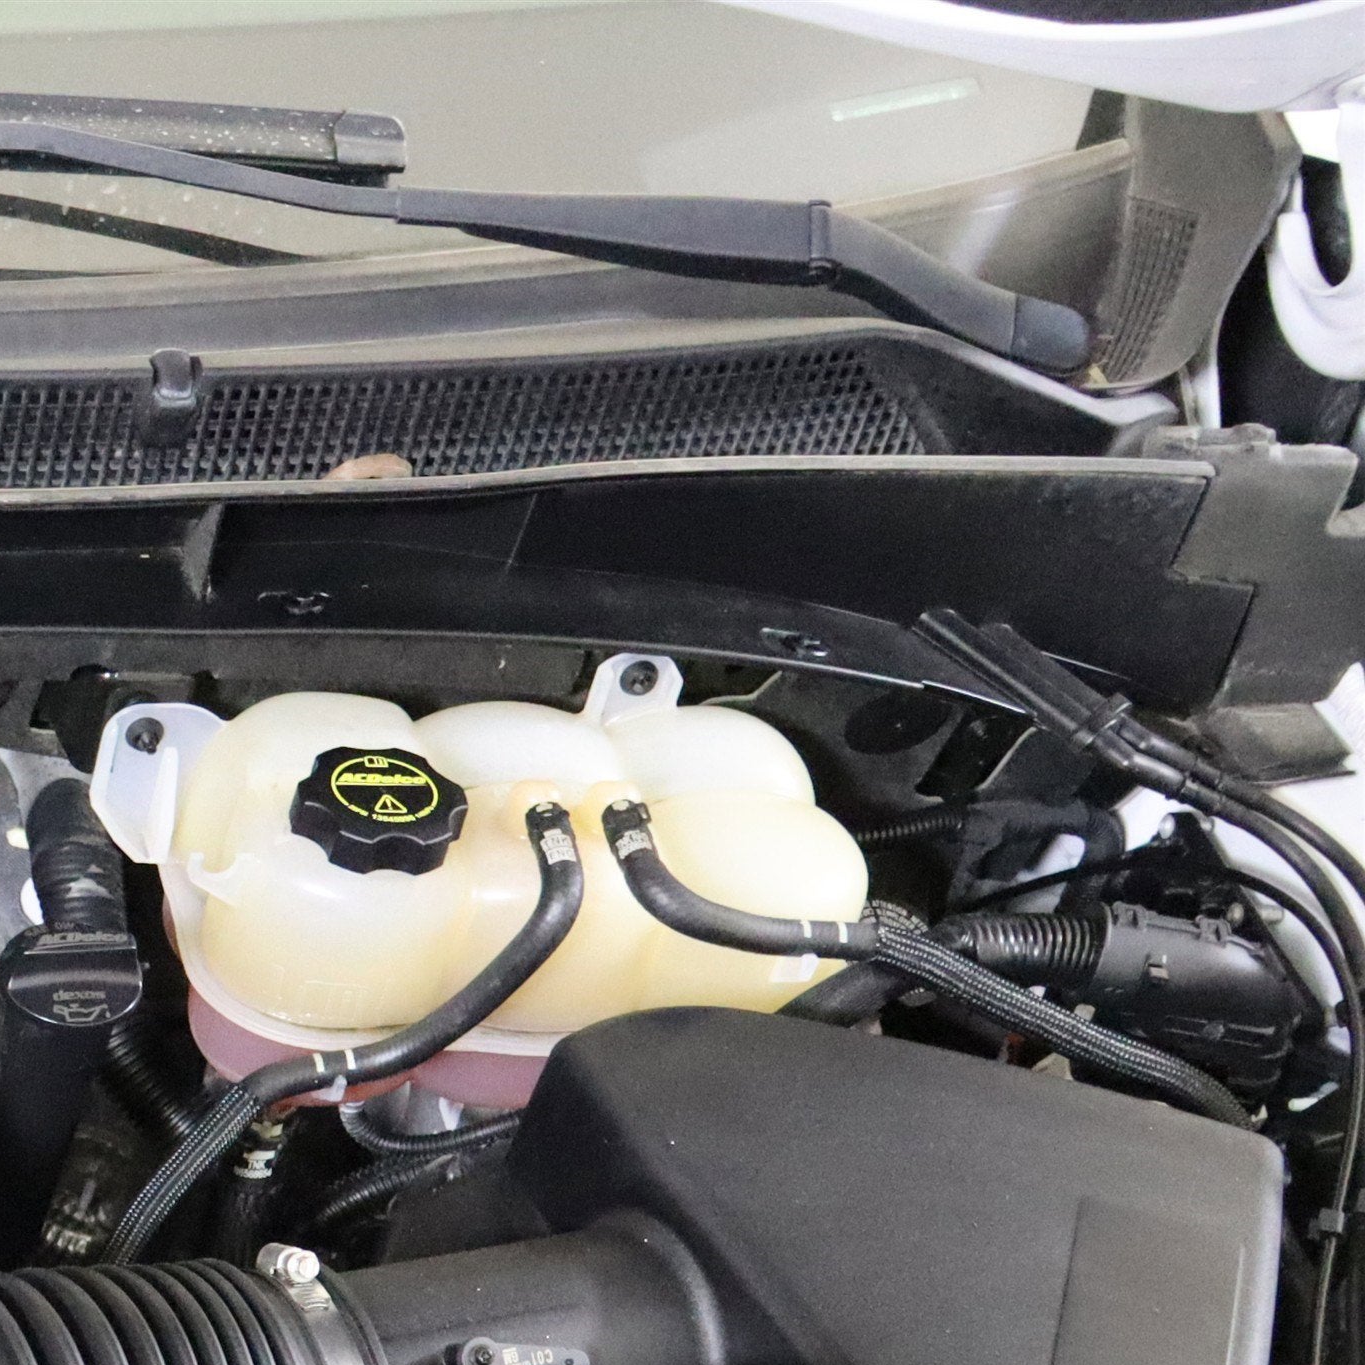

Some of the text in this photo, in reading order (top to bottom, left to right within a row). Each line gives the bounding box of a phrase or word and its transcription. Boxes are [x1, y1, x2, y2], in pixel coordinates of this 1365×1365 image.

[337, 772, 426, 785] ACDelco
[36, 931, 128, 946] ACDelco
[52, 990, 106, 1001] dexos
